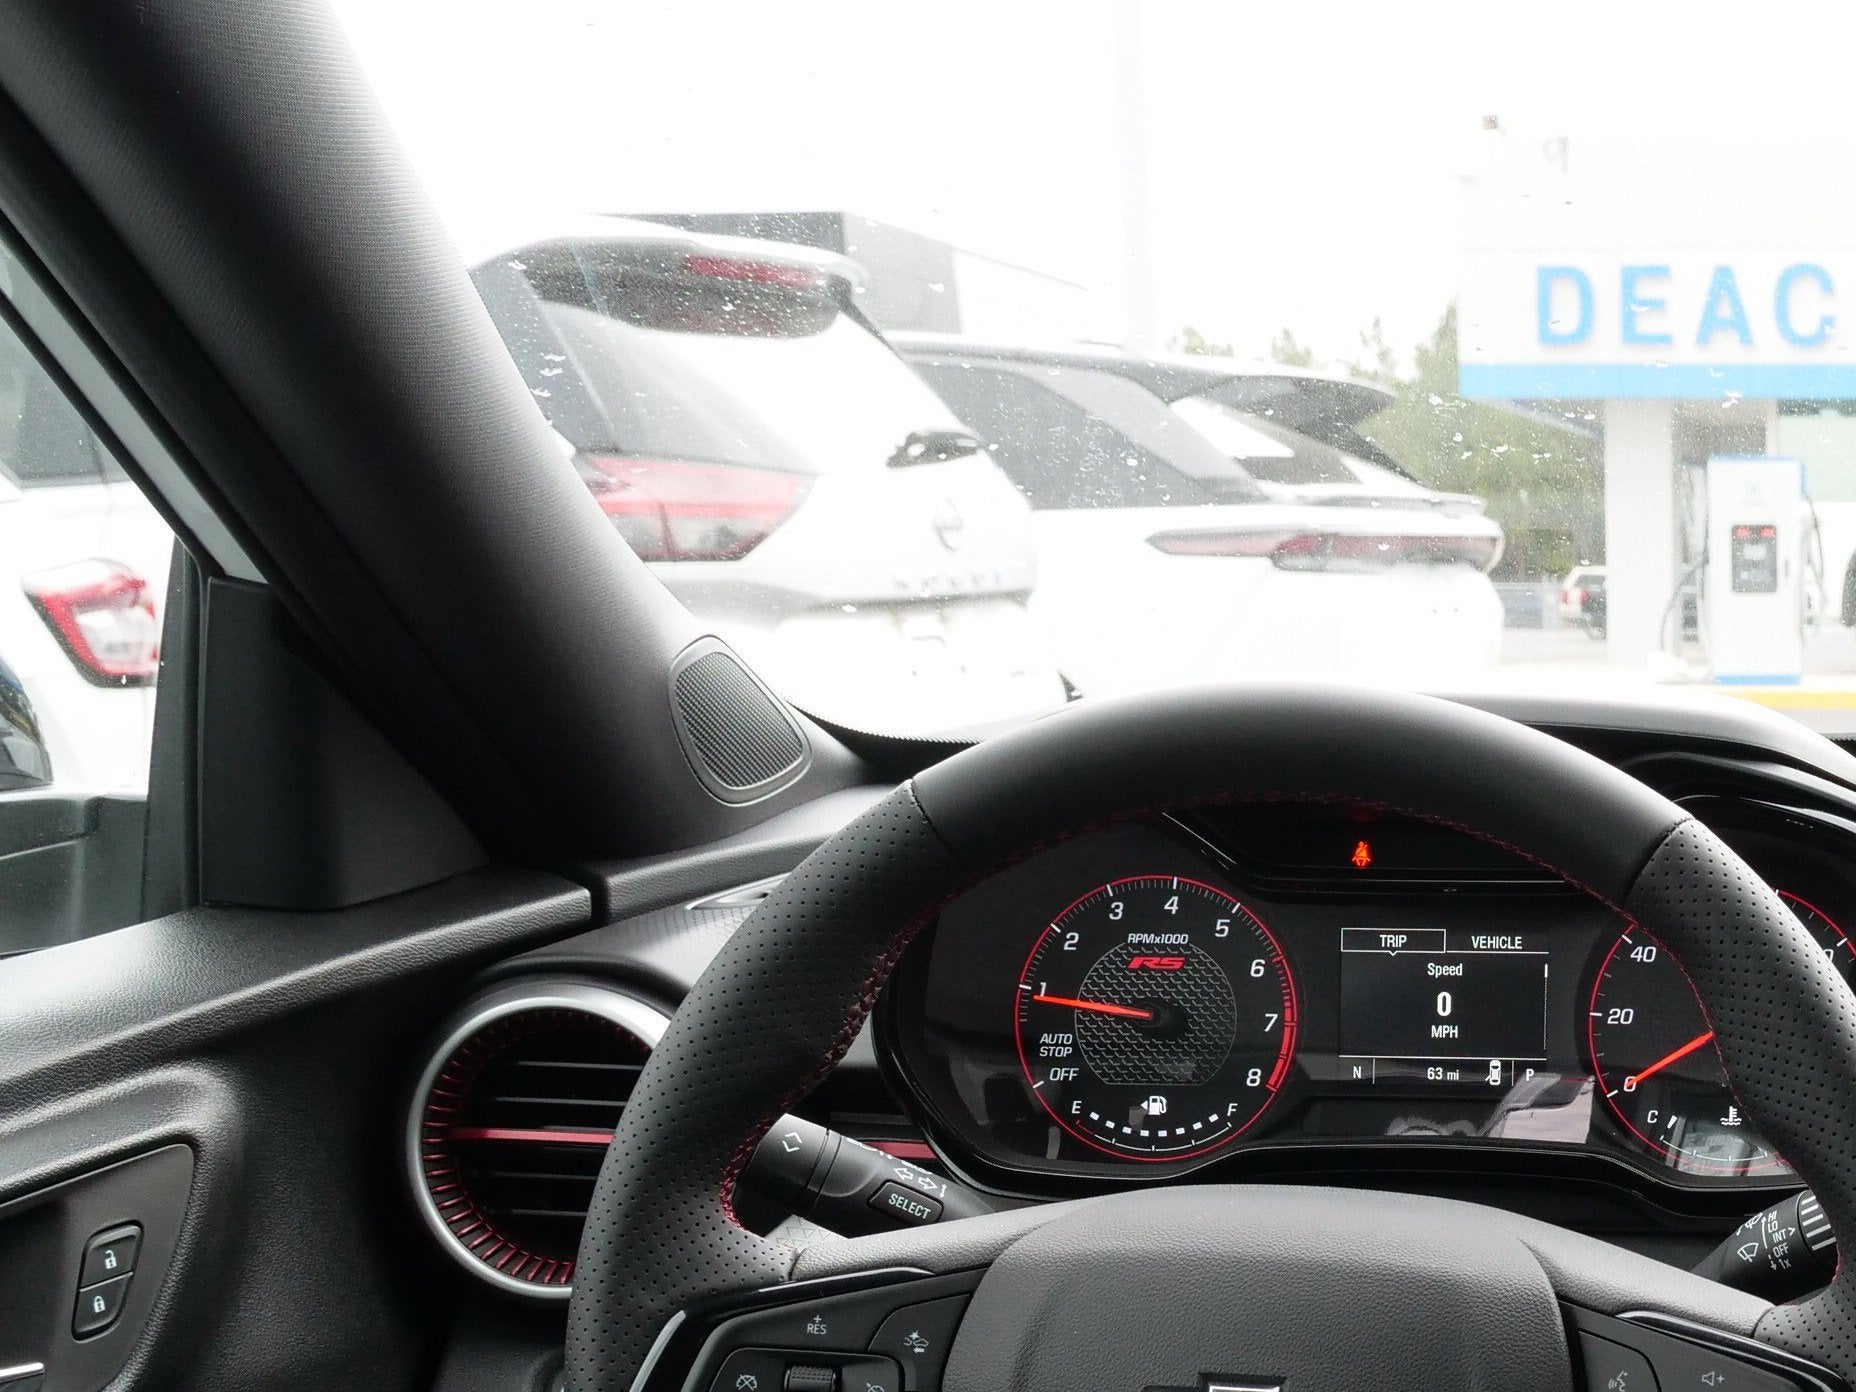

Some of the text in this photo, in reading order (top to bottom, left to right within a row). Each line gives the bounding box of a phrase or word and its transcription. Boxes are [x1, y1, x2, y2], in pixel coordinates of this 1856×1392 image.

[1108, 901, 1124, 920] 3
[1164, 896, 1179, 915] 4
[1215, 919, 1231, 938] 5
[1063, 932, 1079, 951] 2
[1127, 933, 1189, 945] RPMx1000
[1379, 934, 1407, 948] TRIP
[1471, 935, 1523, 950] VEHICLE
[1630, 946, 1657, 963] 40
[1126, 956, 1186, 970] RS
[1250, 959, 1265, 978] 6
[1427, 962, 1463, 979] Speed
[1436, 991, 1452, 1017] 0
[1264, 1013, 1278, 1032] 7
[1607, 1008, 1634, 1025] 20
[1039, 1033, 1073, 1045] AUTO
[1431, 1025, 1459, 1039] MPH
[1039, 1046, 1073, 1058] STOP
[1049, 1068, 1079, 1081] OFF
[1246, 1068, 1262, 1087] 8
[1353, 1066, 1362, 1079] N
[1427, 1067, 1460, 1081] 63 mi
[1526, 1068, 1535, 1081] P
[1623, 1075, 1637, 1092] 0
[1071, 1100, 1082, 1115] E
[1227, 1102, 1238, 1117] F
[1646, 1110, 1659, 1125] C
[888, 1193, 931, 1220] SELECT
[1767, 1210, 1778, 1223] HI
[1767, 1221, 1778, 1233] LO
[1772, 1228, 1787, 1243] INT
[1773, 1242, 1788, 1258] OFF
[806, 1323, 827, 1335] RES
